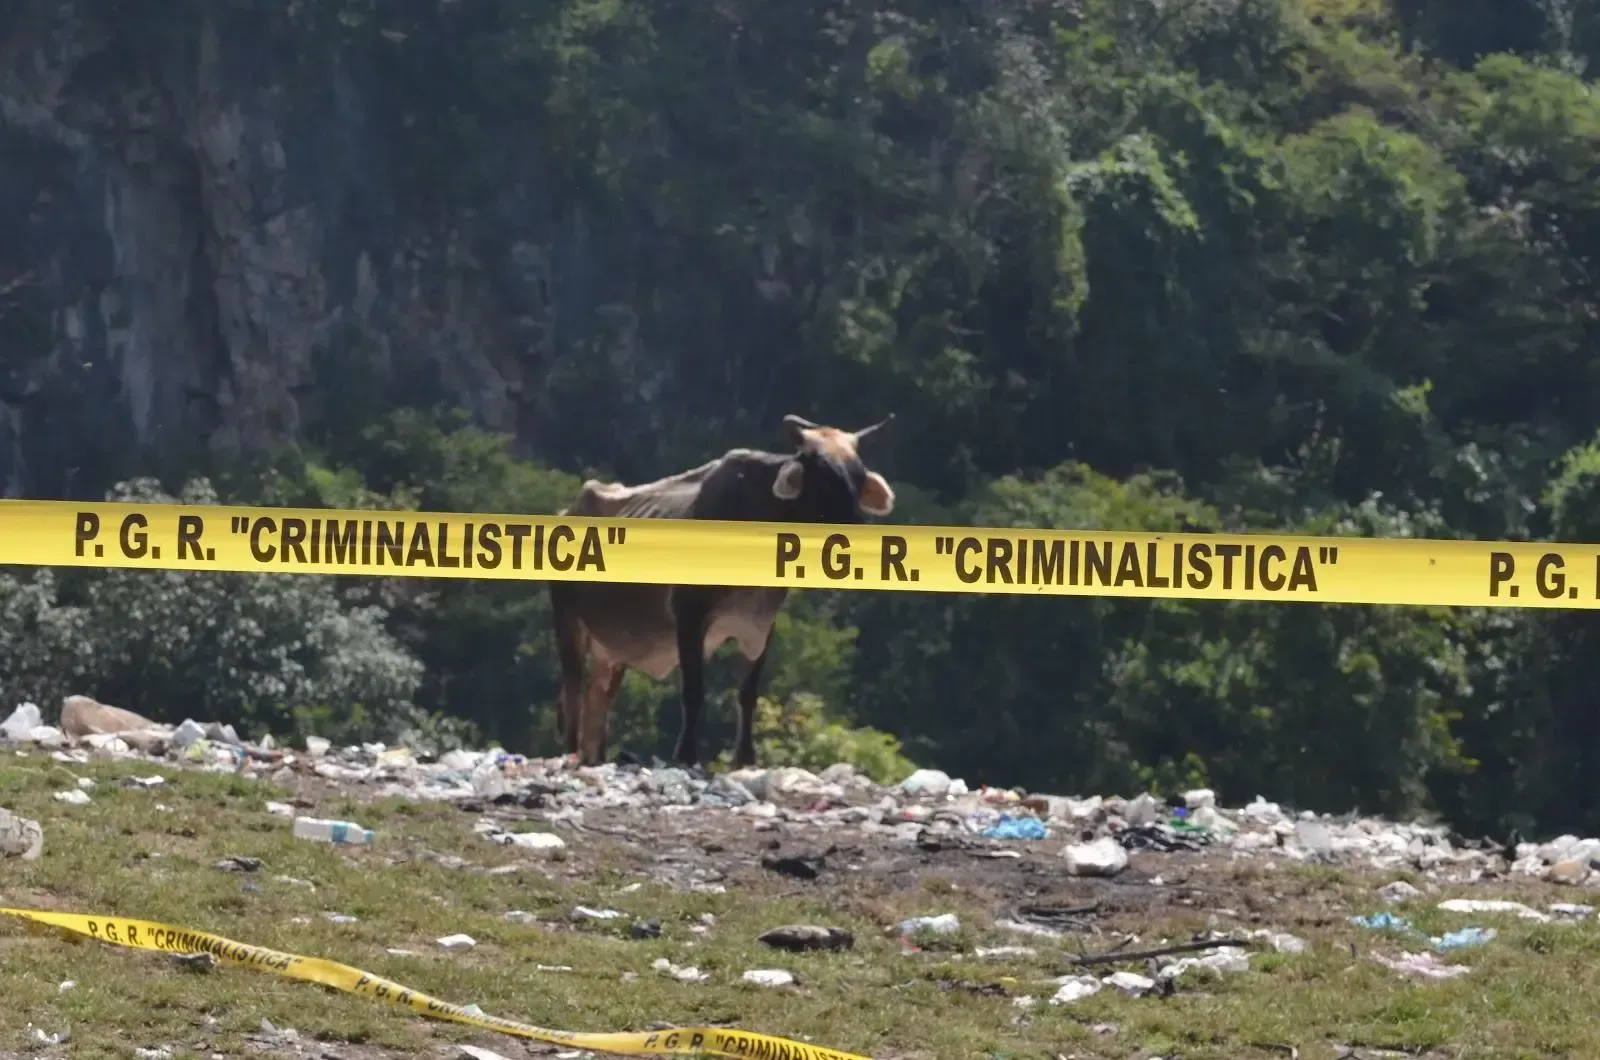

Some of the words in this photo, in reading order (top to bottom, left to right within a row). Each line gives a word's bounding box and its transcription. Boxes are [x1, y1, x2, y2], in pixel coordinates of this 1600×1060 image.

[76, 512, 104, 558] P.
[120, 514, 161, 559] G.
[178, 516, 215, 561] R.
[231, 517, 626, 572] "CRIMINALISTICA"
[777, 533, 805, 579] P.
[822, 534, 864, 580] G.
[881, 536, 920, 582] R.
[935, 537, 1338, 592] "CRIMINALISTICA"
[1490, 552, 1520, 597] P.
[1536, 553, 1578, 599] G.
[106, 922, 124, 942] G.
[128, 925, 143, 945] R.
